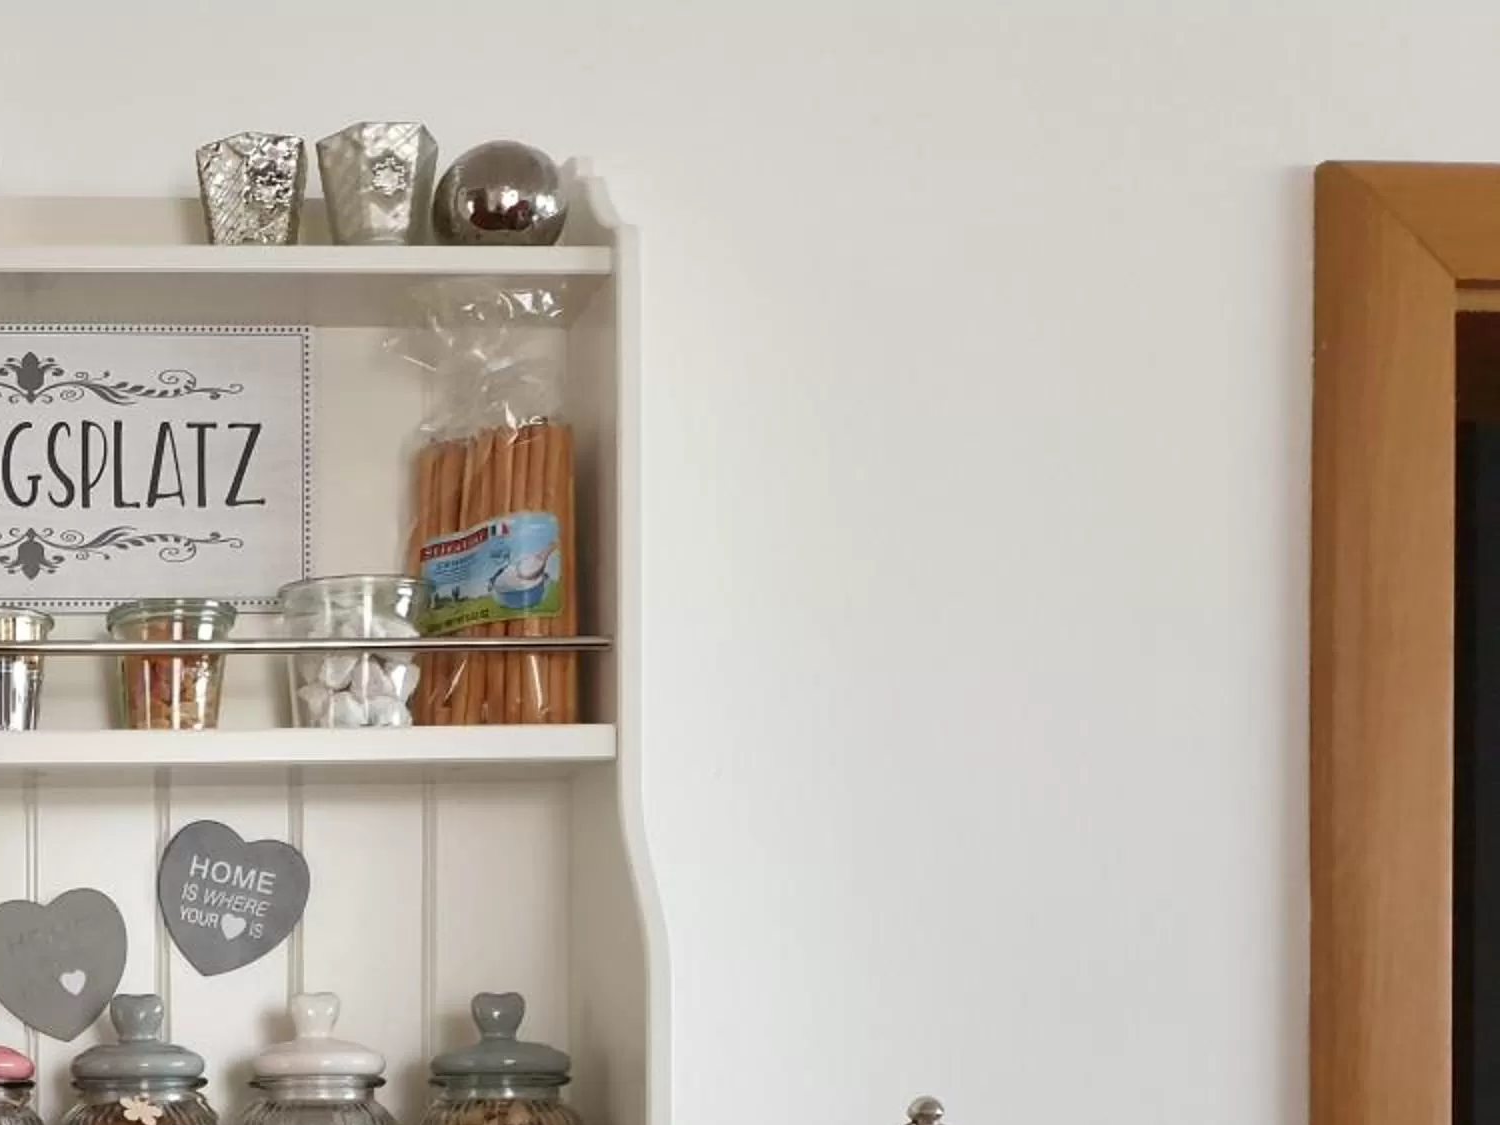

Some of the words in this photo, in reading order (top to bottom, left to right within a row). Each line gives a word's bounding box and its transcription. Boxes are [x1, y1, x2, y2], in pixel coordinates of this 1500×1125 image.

[189, 854, 277, 895] HOME
[181, 881, 199, 902] IS
[203, 888, 271, 917] WHERE
[180, 905, 219, 929] YOUR
[248, 922, 265, 940] IS
